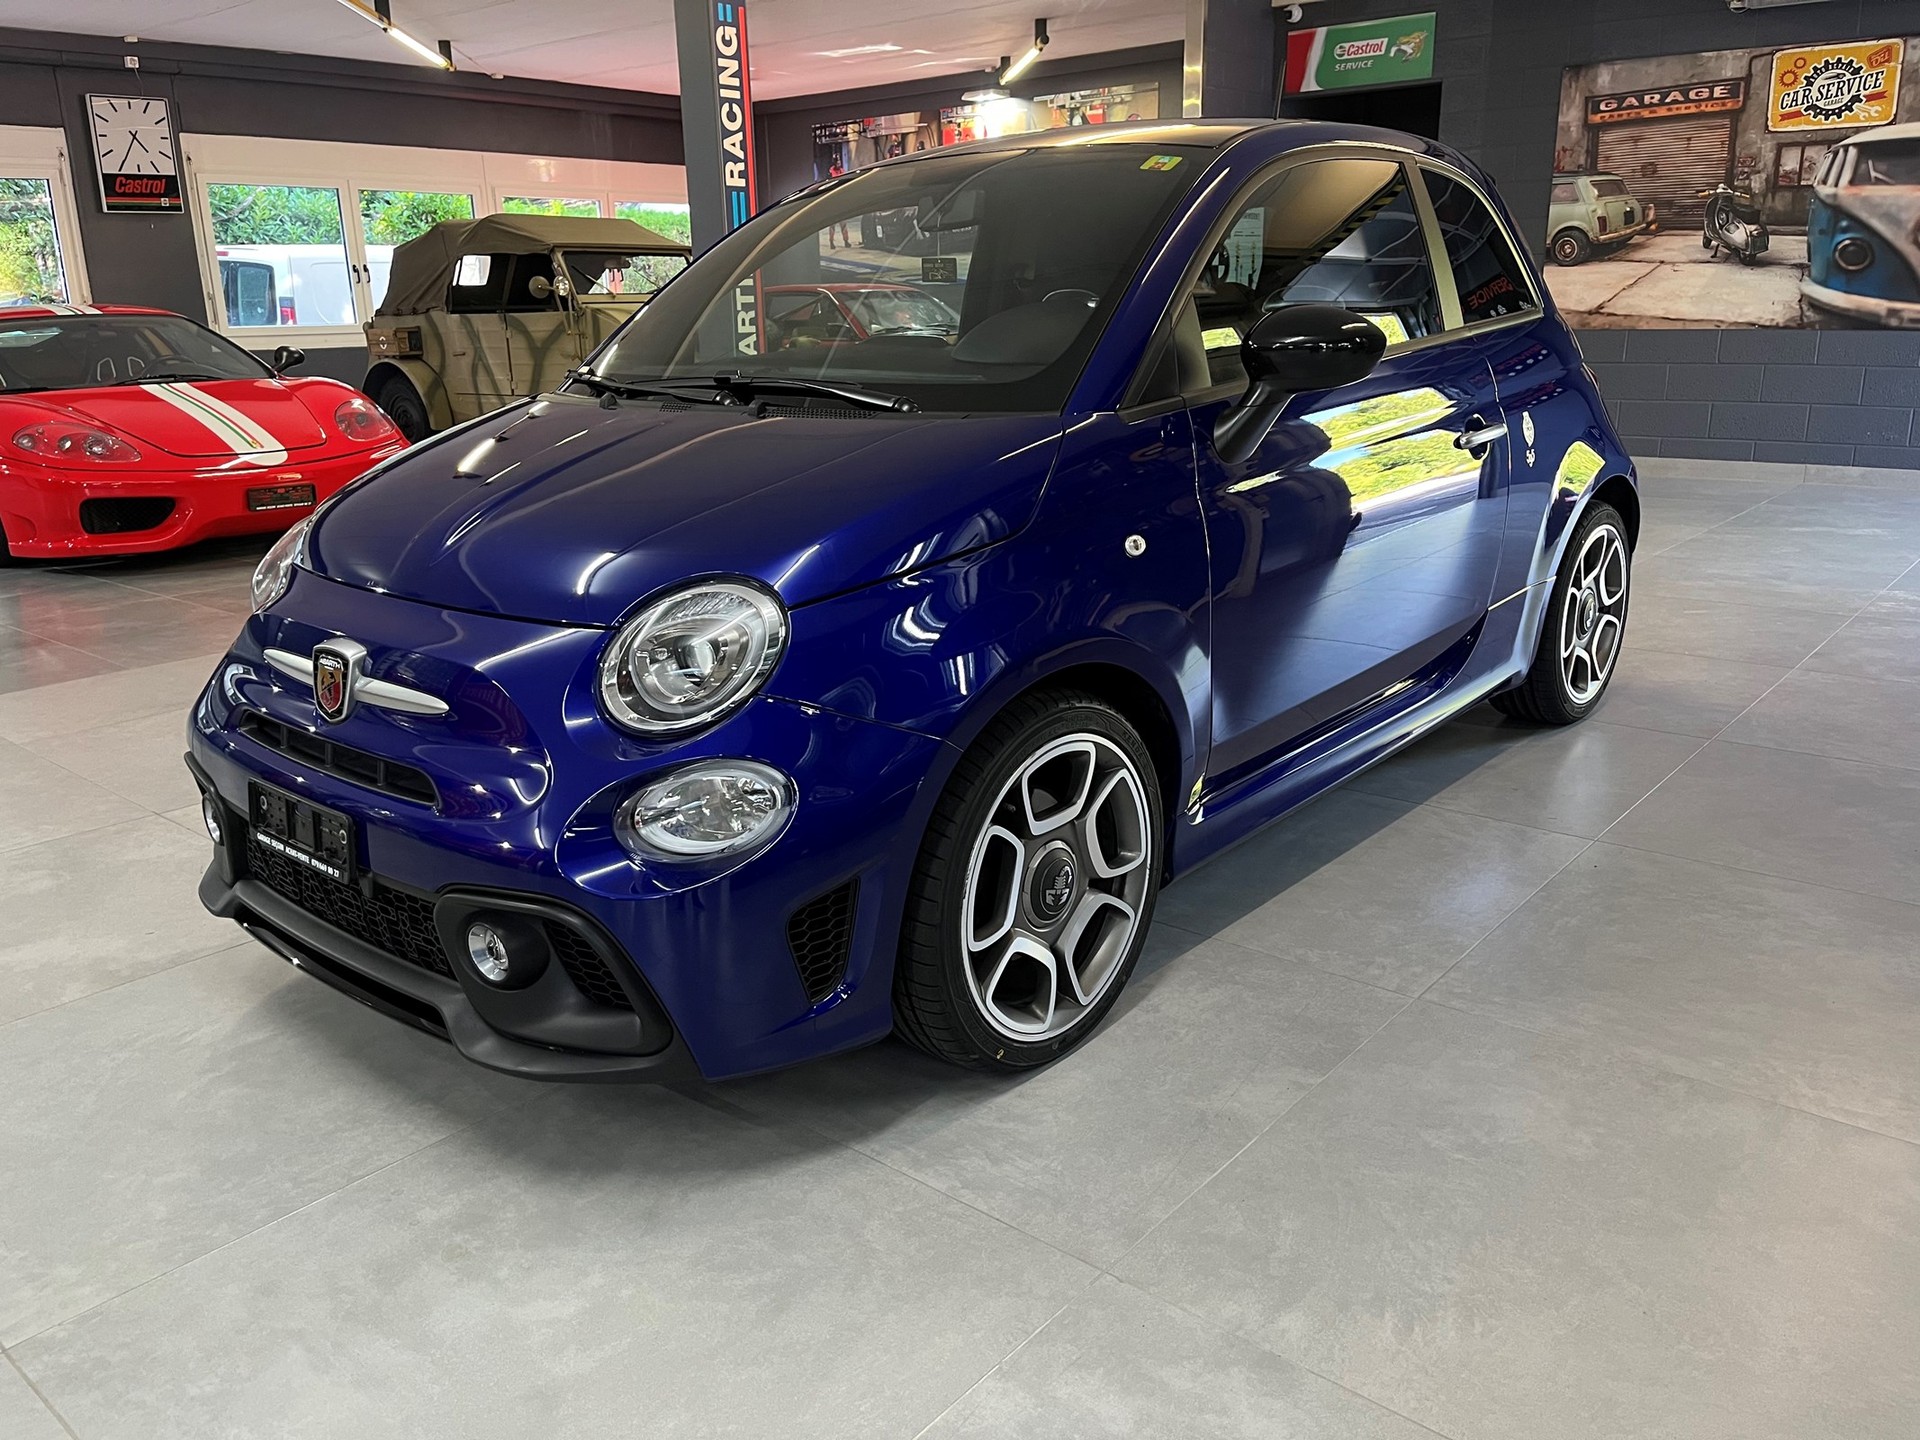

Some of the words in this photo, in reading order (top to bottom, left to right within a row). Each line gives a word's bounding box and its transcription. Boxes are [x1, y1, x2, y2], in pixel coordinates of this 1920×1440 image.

[1347, 41, 1384, 57] Castrol
[1334, 60, 1374, 72] SERVICE
[1599, 85, 1732, 111] GARAGE
[1780, 87, 1813, 110] CAR
[1815, 70, 1885, 102] SERVICE
[715, 25, 746, 188] RACING
[115, 176, 166, 194] Castrol
[735, 274, 758, 356] ARTI
